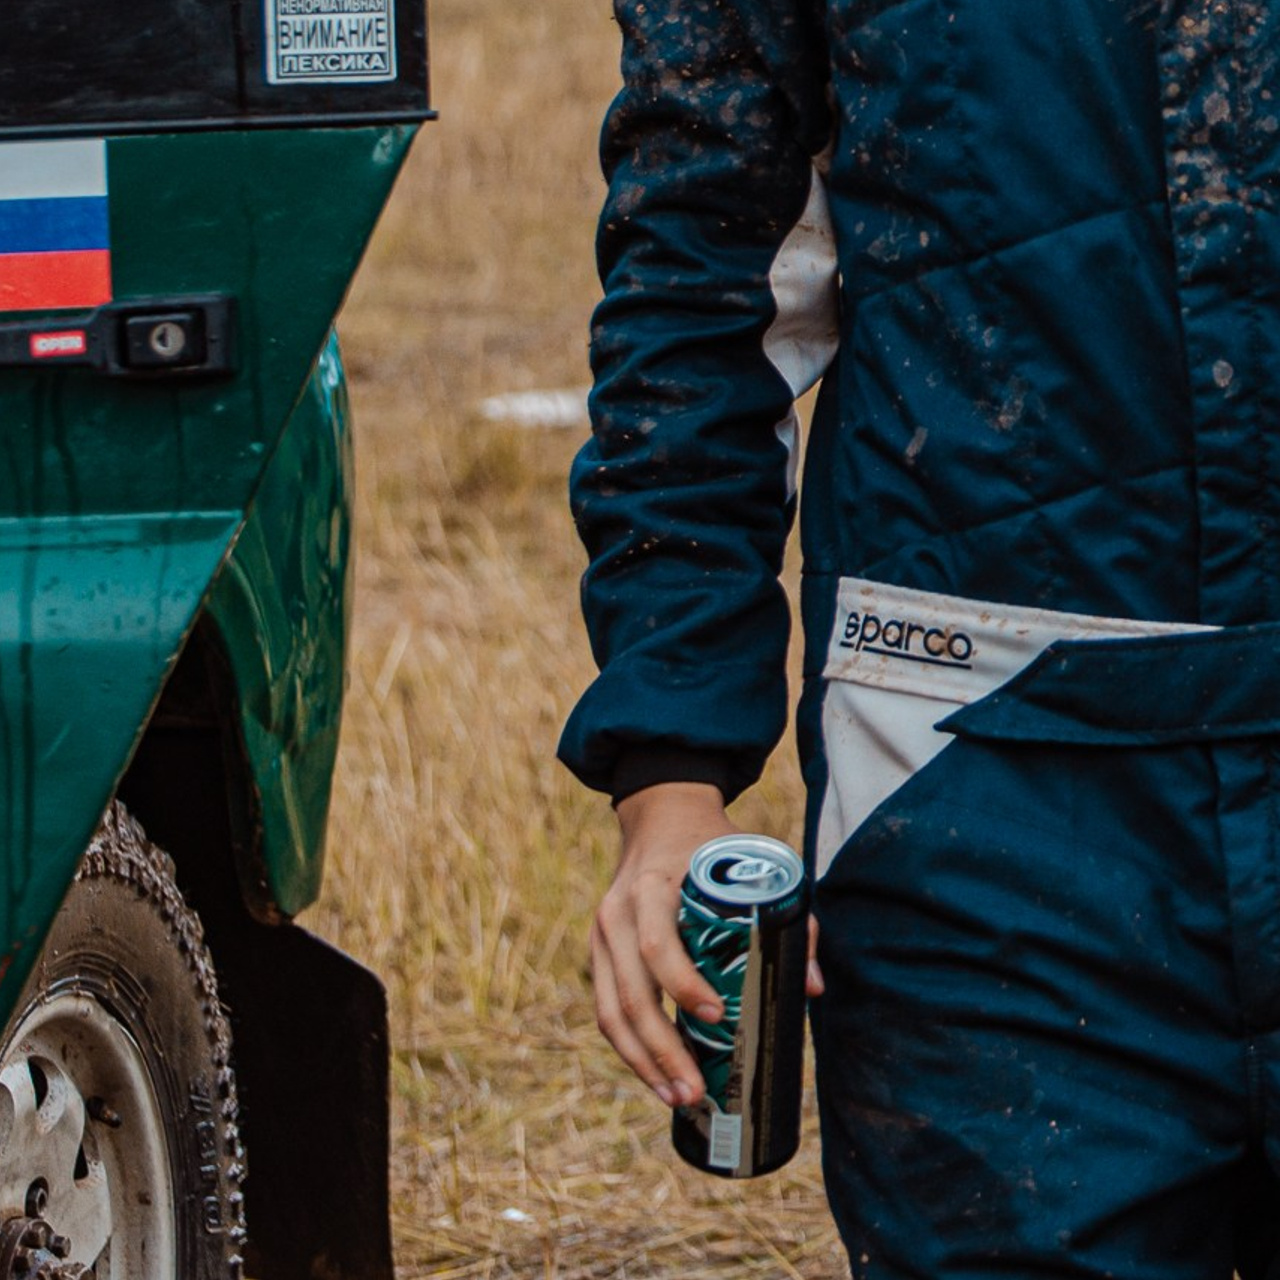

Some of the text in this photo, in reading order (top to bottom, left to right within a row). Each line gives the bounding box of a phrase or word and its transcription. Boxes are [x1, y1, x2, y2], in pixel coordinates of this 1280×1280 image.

[280, 18, 387, 49] ВНИМАНИЕ
[282, 53, 386, 73] ЛЕКСИКА
[844, 611, 973, 661] sparco
